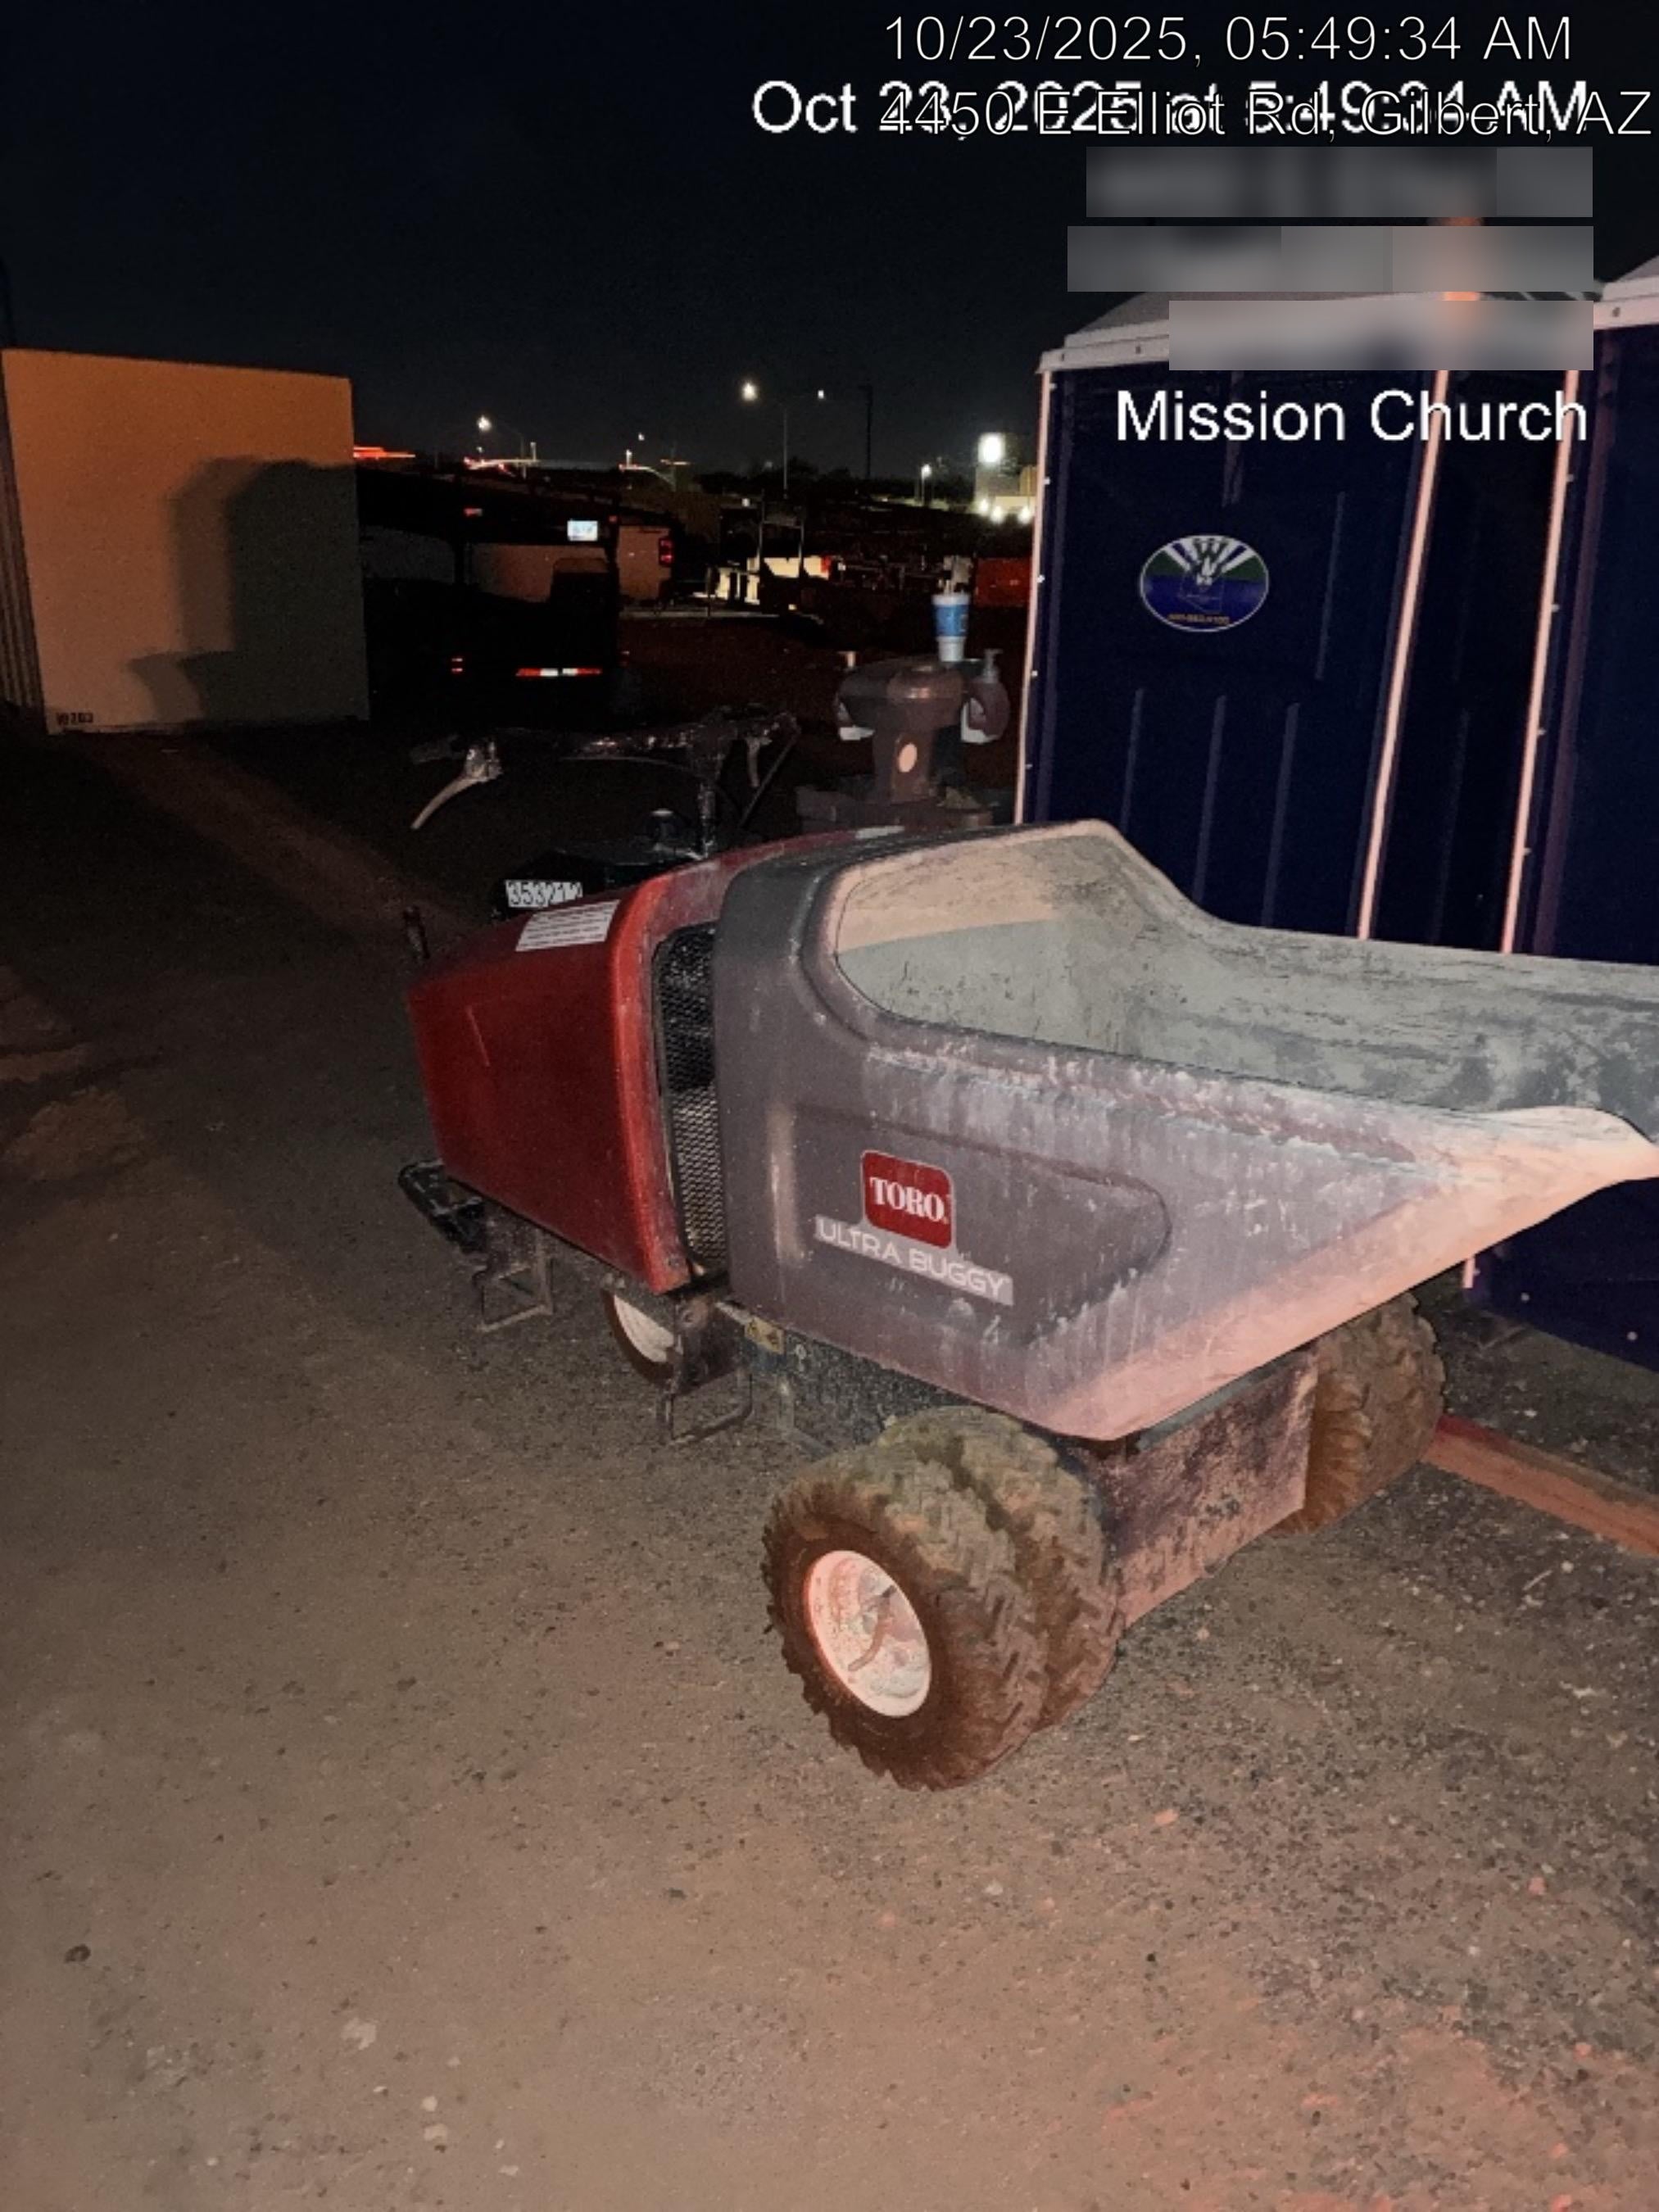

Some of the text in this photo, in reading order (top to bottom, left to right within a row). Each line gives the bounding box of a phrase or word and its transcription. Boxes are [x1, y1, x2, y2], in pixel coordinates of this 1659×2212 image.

[870, 1176, 945, 1223] TORO
[819, 1217, 1006, 1301] ULTRA BUGGY
